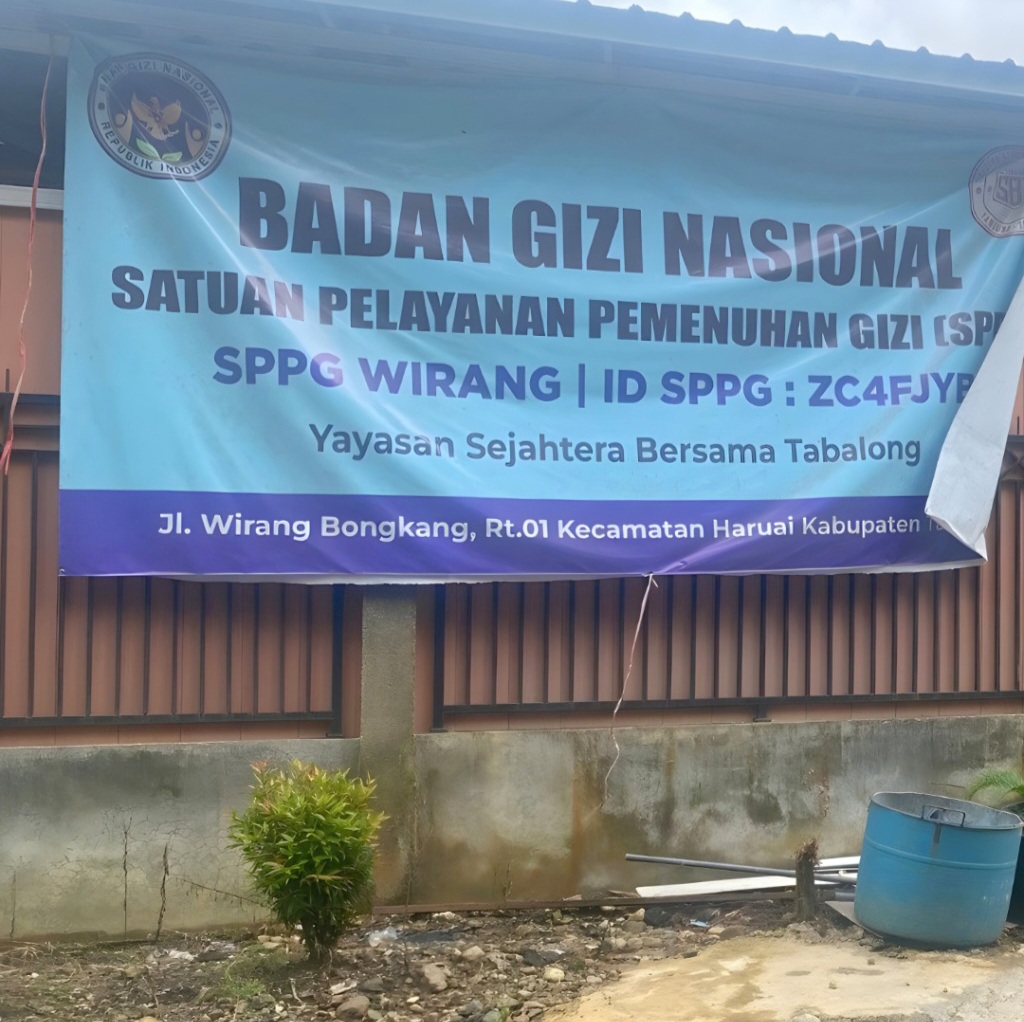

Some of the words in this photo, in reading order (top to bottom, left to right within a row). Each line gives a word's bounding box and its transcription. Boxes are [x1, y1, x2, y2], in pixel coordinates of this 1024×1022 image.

[162, 62, 219, 114] NASIONAL
[100, 121, 153, 170] REPUBLIK
[160, 139, 220, 176] INDONESIA
[238, 177, 490, 264] BADAN
[512, 199, 644, 274] GIZI
[663, 211, 963, 290] NASIONAL
[111, 265, 304, 321] SATUAN
[319, 286, 575, 338] PELAYANAN
[589, 299, 838, 350] PEMENUHAN
[848, 313, 924, 351] GIZI
[213, 346, 344, 388] SPPG
[359, 358, 561, 402] WIRANG
[603, 369, 648, 403] ID
[660, 371, 773, 408] SPPG
[308, 423, 455, 461] Yayasan
[466, 431, 625, 468] Sejahtera
[636, 436, 776, 464] Bersama
[784, 436, 922, 467] Tabalong
[158, 511, 192, 536] Jl.
[201, 512, 311, 541] Wirang
[320, 515, 478, 543] Bongkang,
[485, 518, 550, 540] Rt.01
[557, 519, 705, 541] Kecamatan
[713, 515, 795, 539] Haruai
[802, 515, 921, 539] Kabupaten
